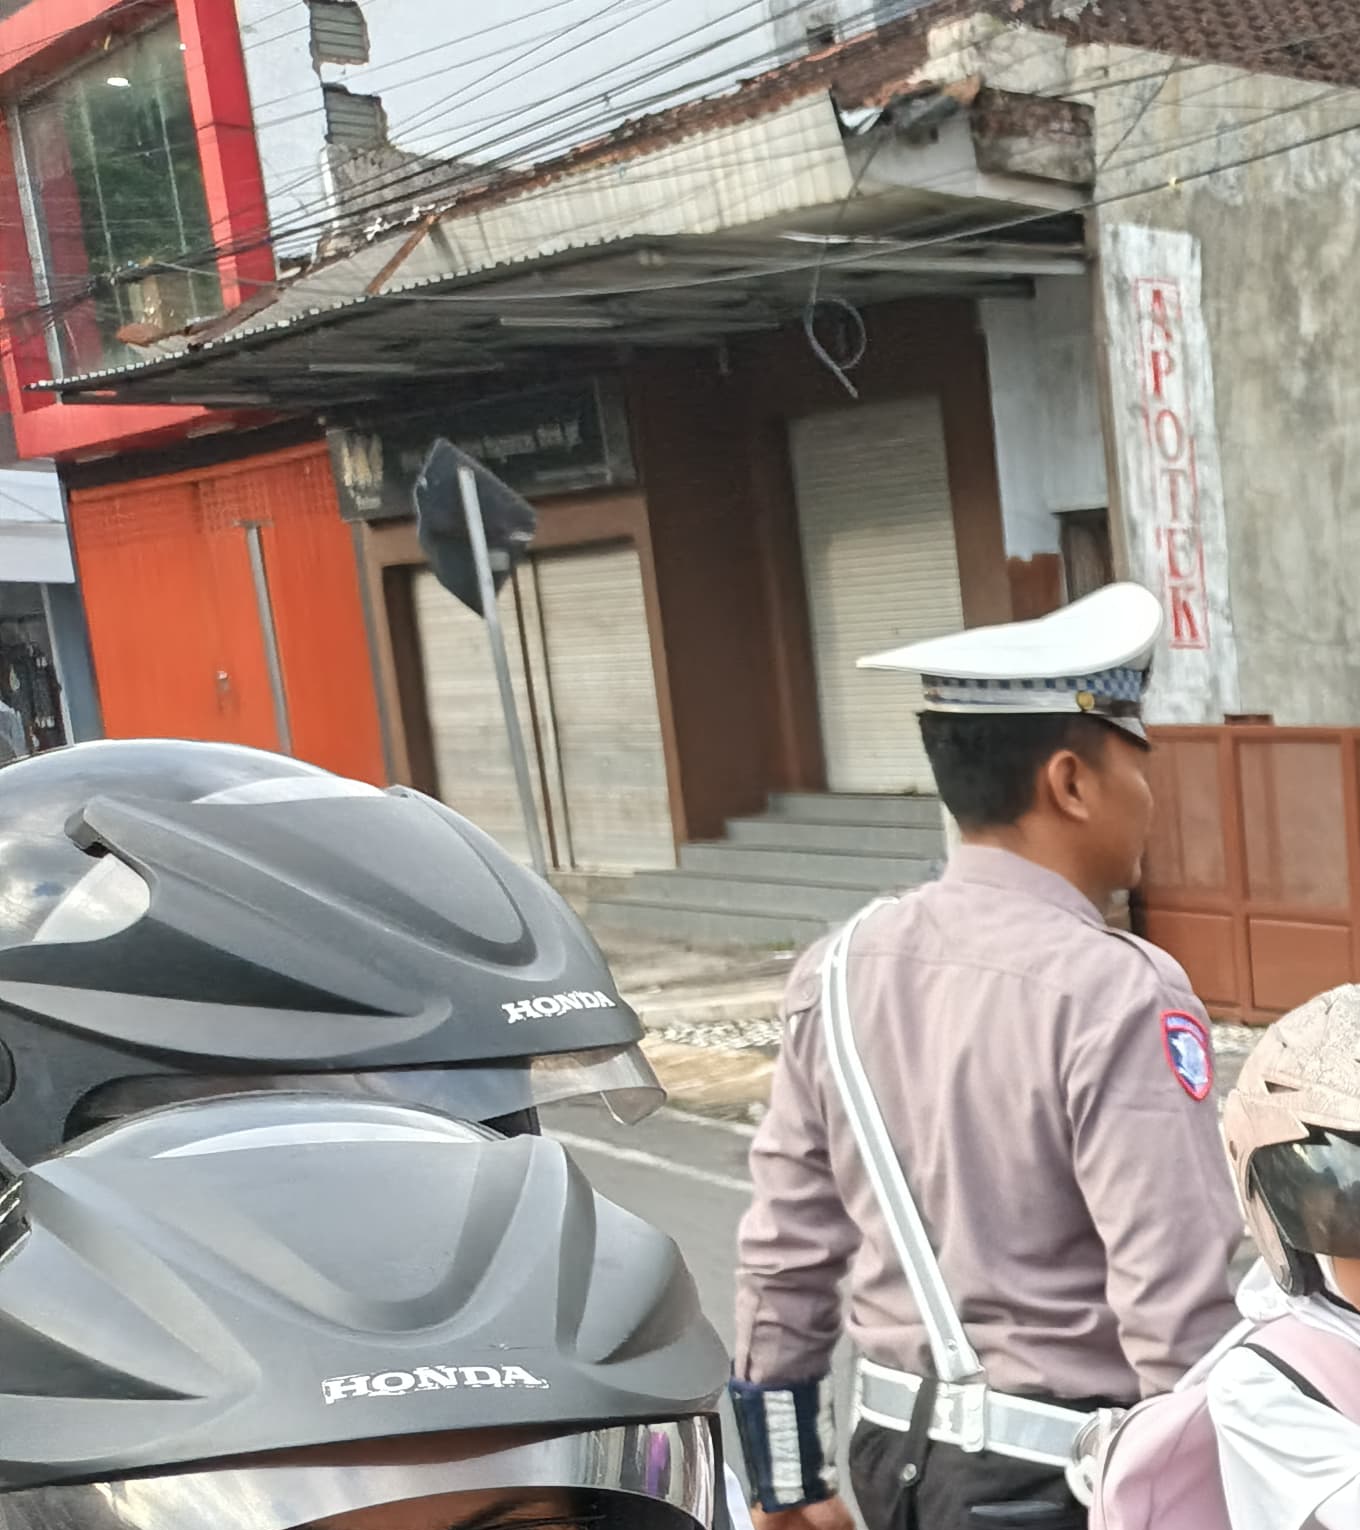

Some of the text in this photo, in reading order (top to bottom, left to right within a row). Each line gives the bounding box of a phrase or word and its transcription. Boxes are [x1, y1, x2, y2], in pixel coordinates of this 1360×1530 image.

[1150, 288, 1200, 642] APOTEK
[501, 989, 617, 1024] HONDA
[321, 1364, 550, 1405] HONDA
